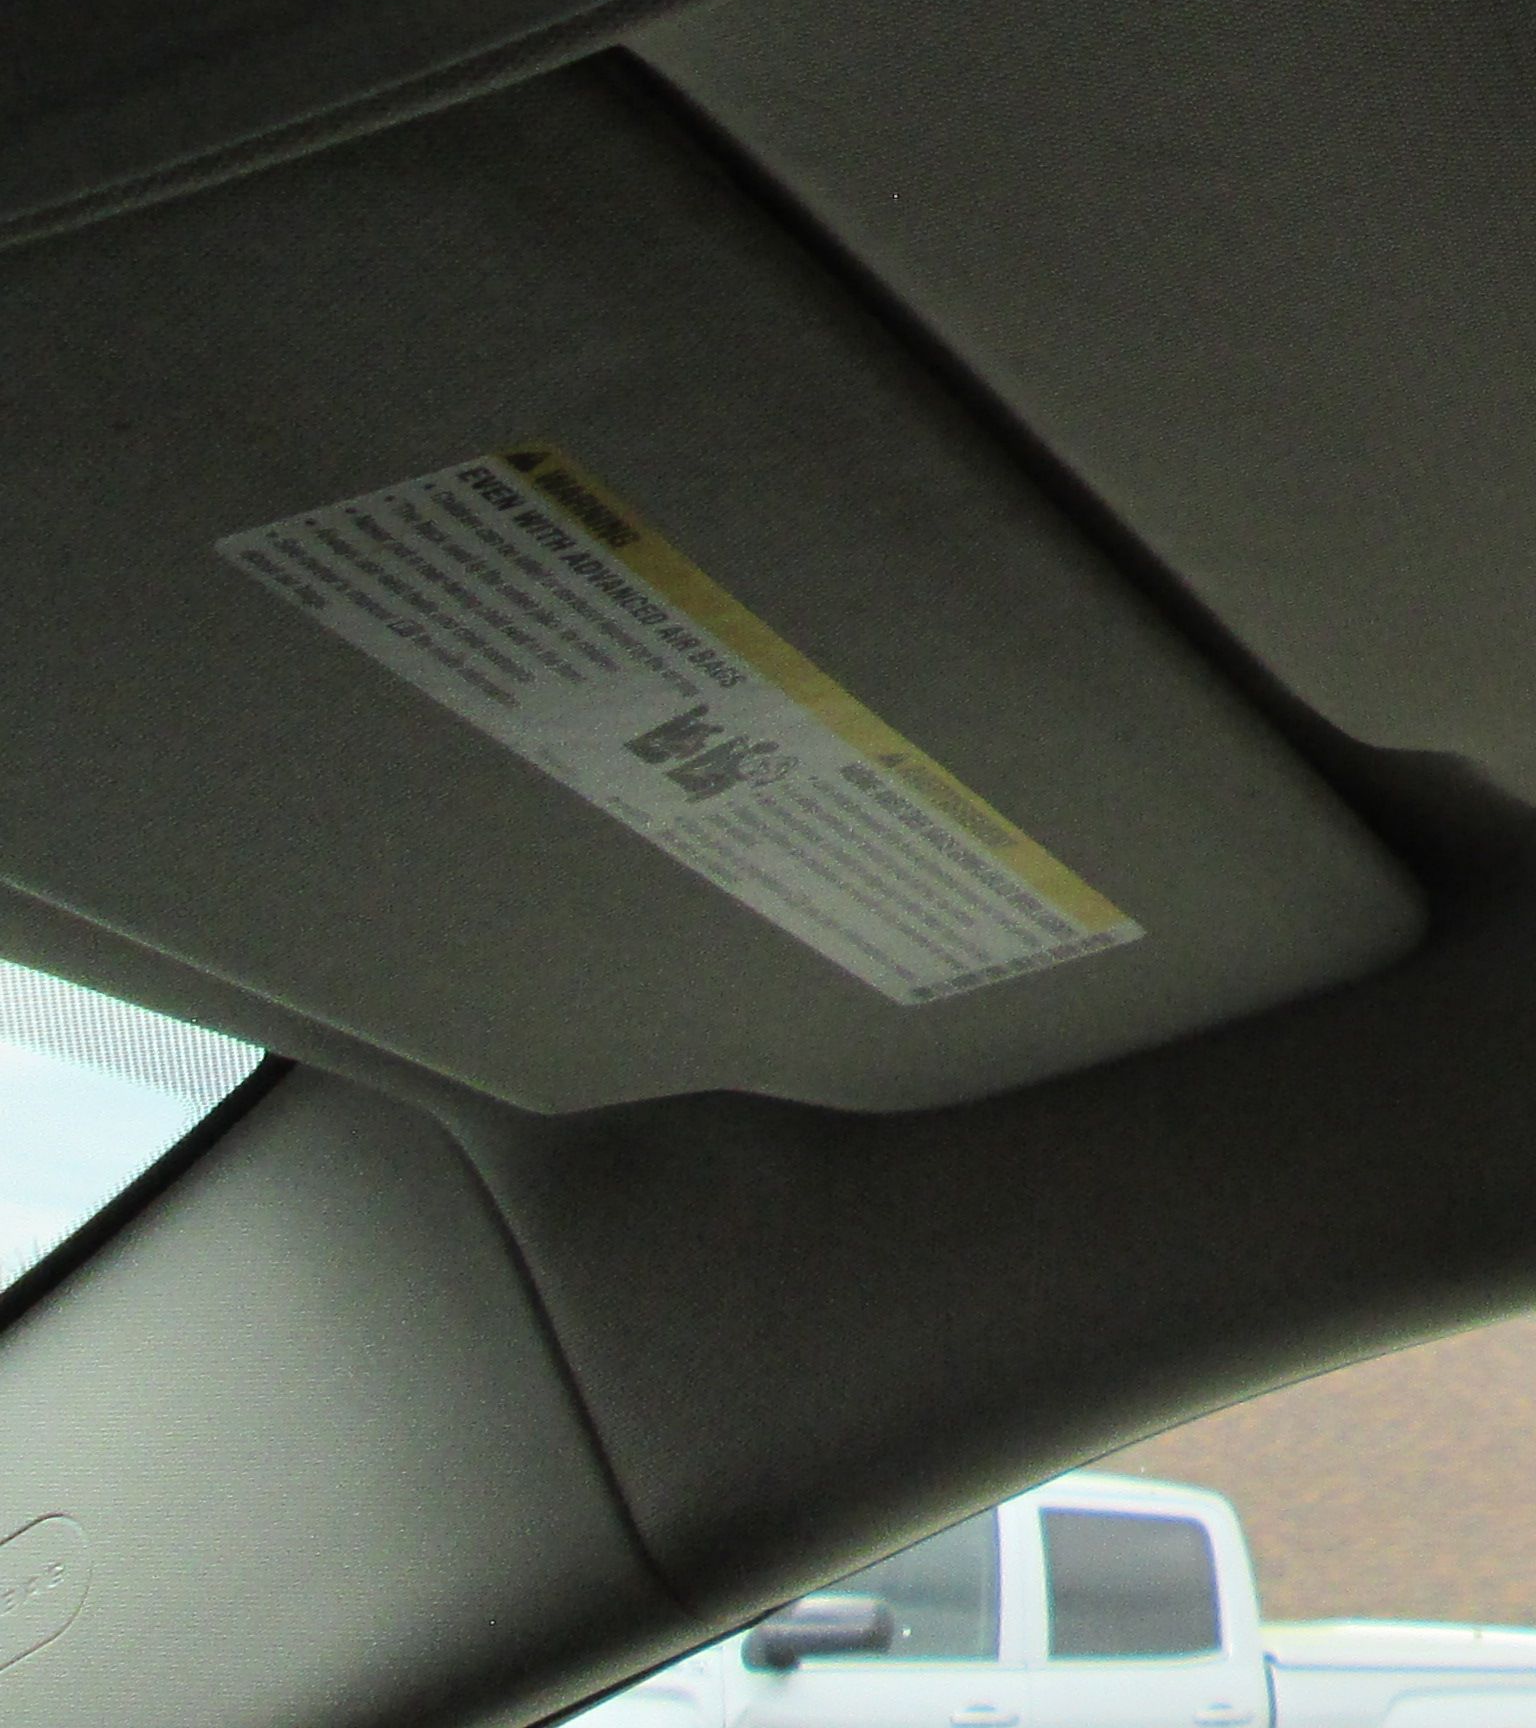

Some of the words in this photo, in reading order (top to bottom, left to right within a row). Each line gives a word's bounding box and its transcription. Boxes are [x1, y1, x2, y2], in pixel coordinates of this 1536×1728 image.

[456, 466, 525, 511] EVEN
[512, 510, 576, 551] WITH
[559, 551, 669, 625] ADVANCED
[656, 625, 701, 652] AIR
[687, 650, 748, 688] BAGS
[534, 469, 642, 547] WARNING
